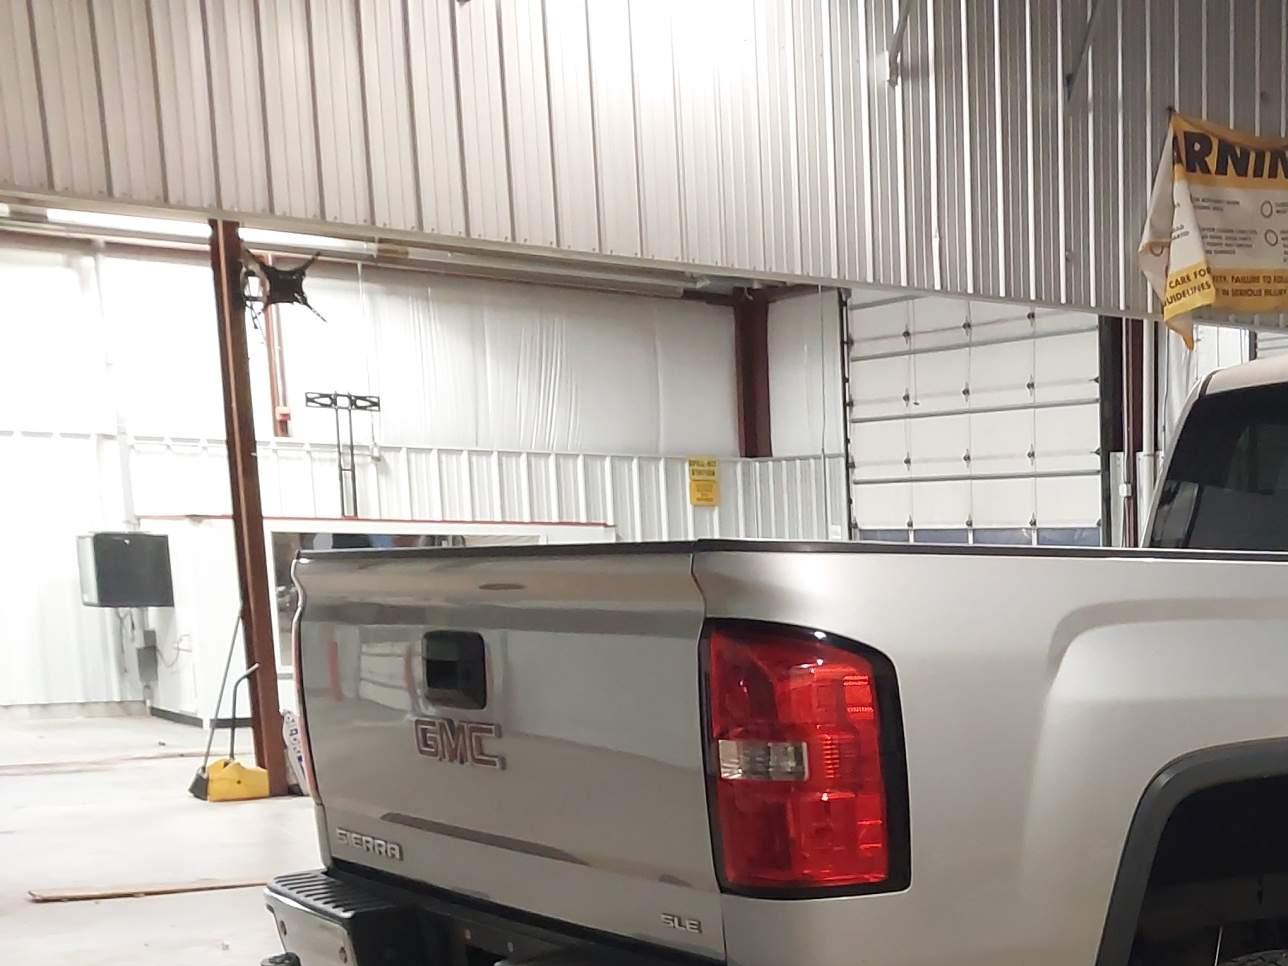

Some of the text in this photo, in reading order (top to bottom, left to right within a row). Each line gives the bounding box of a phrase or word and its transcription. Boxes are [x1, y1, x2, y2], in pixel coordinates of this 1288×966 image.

[1168, 273, 1192, 289] CARE
[414, 717, 502, 769] GMC
[335, 827, 402, 860] SIERRA
[660, 913, 701, 934] SLE
